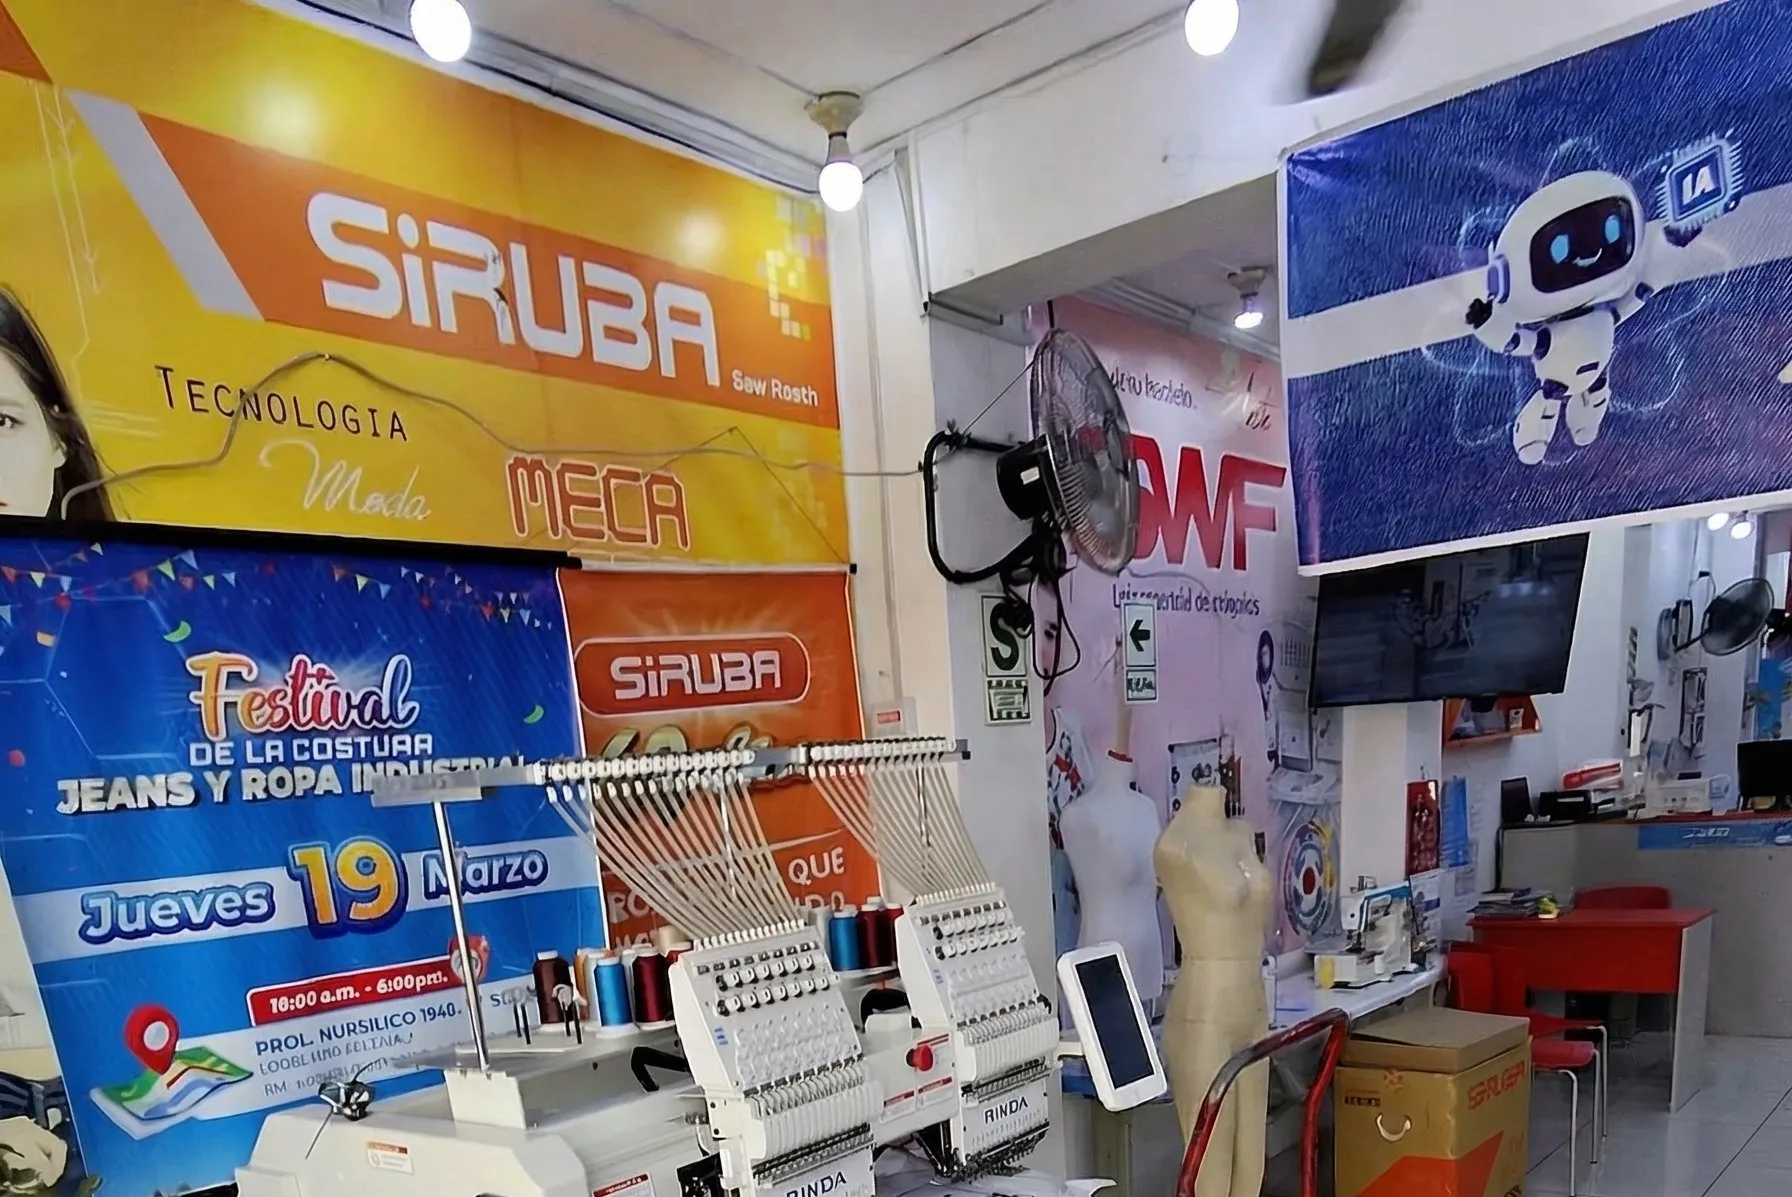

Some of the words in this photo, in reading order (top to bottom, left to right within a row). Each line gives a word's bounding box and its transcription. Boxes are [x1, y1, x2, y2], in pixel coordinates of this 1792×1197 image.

[1682, 165, 1715, 205] IA
[506, 453, 690, 551] MECA
[186, 651, 420, 741] Festival
[190, 742, 234, 767] DE
[246, 738, 284, 763] LA
[56, 771, 195, 814] JEANS
[204, 770, 231, 803] Y
[241, 764, 342, 801] ROPA
[788, 847, 845, 886] QUE
[82, 884, 273, 942] Jueves
[291, 839, 404, 932] 19
[984, 1095, 1029, 1125] RINDA
